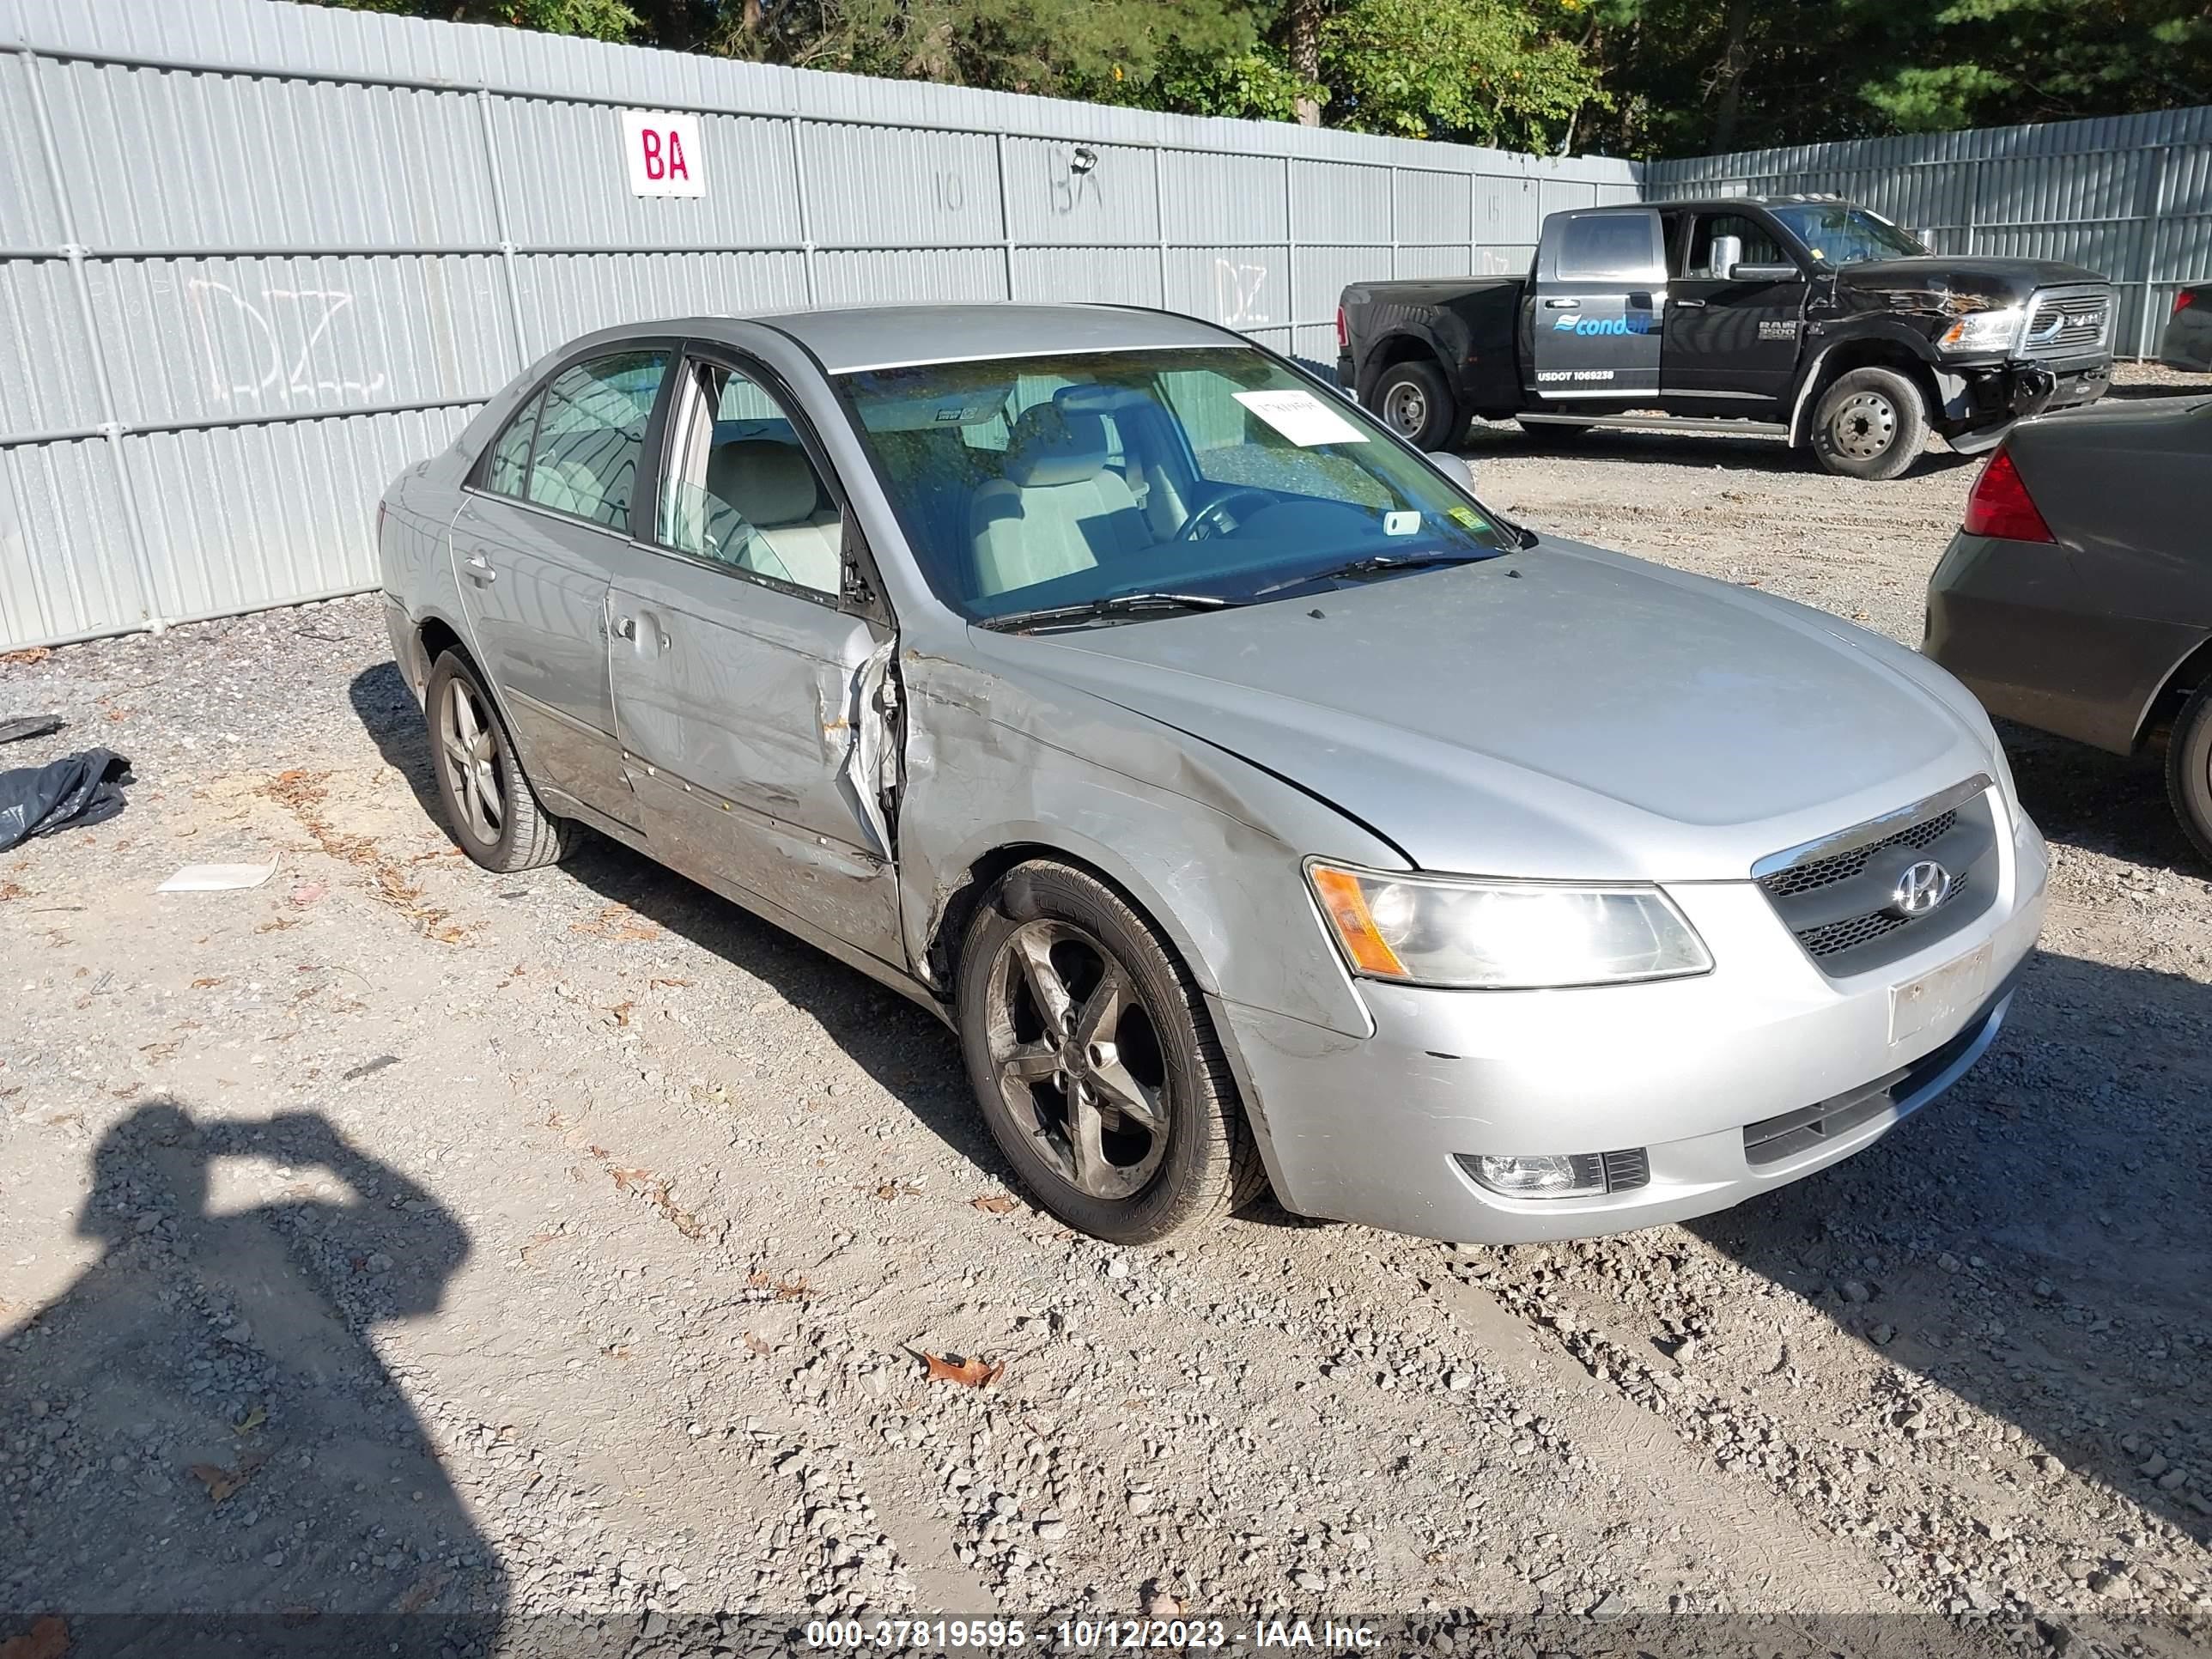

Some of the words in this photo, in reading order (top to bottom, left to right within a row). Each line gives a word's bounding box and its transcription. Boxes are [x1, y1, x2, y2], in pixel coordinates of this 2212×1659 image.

[642, 129, 689, 180] BA
[189, 277, 385, 402] DZ
[1537, 372, 1572, 381] USDOT
